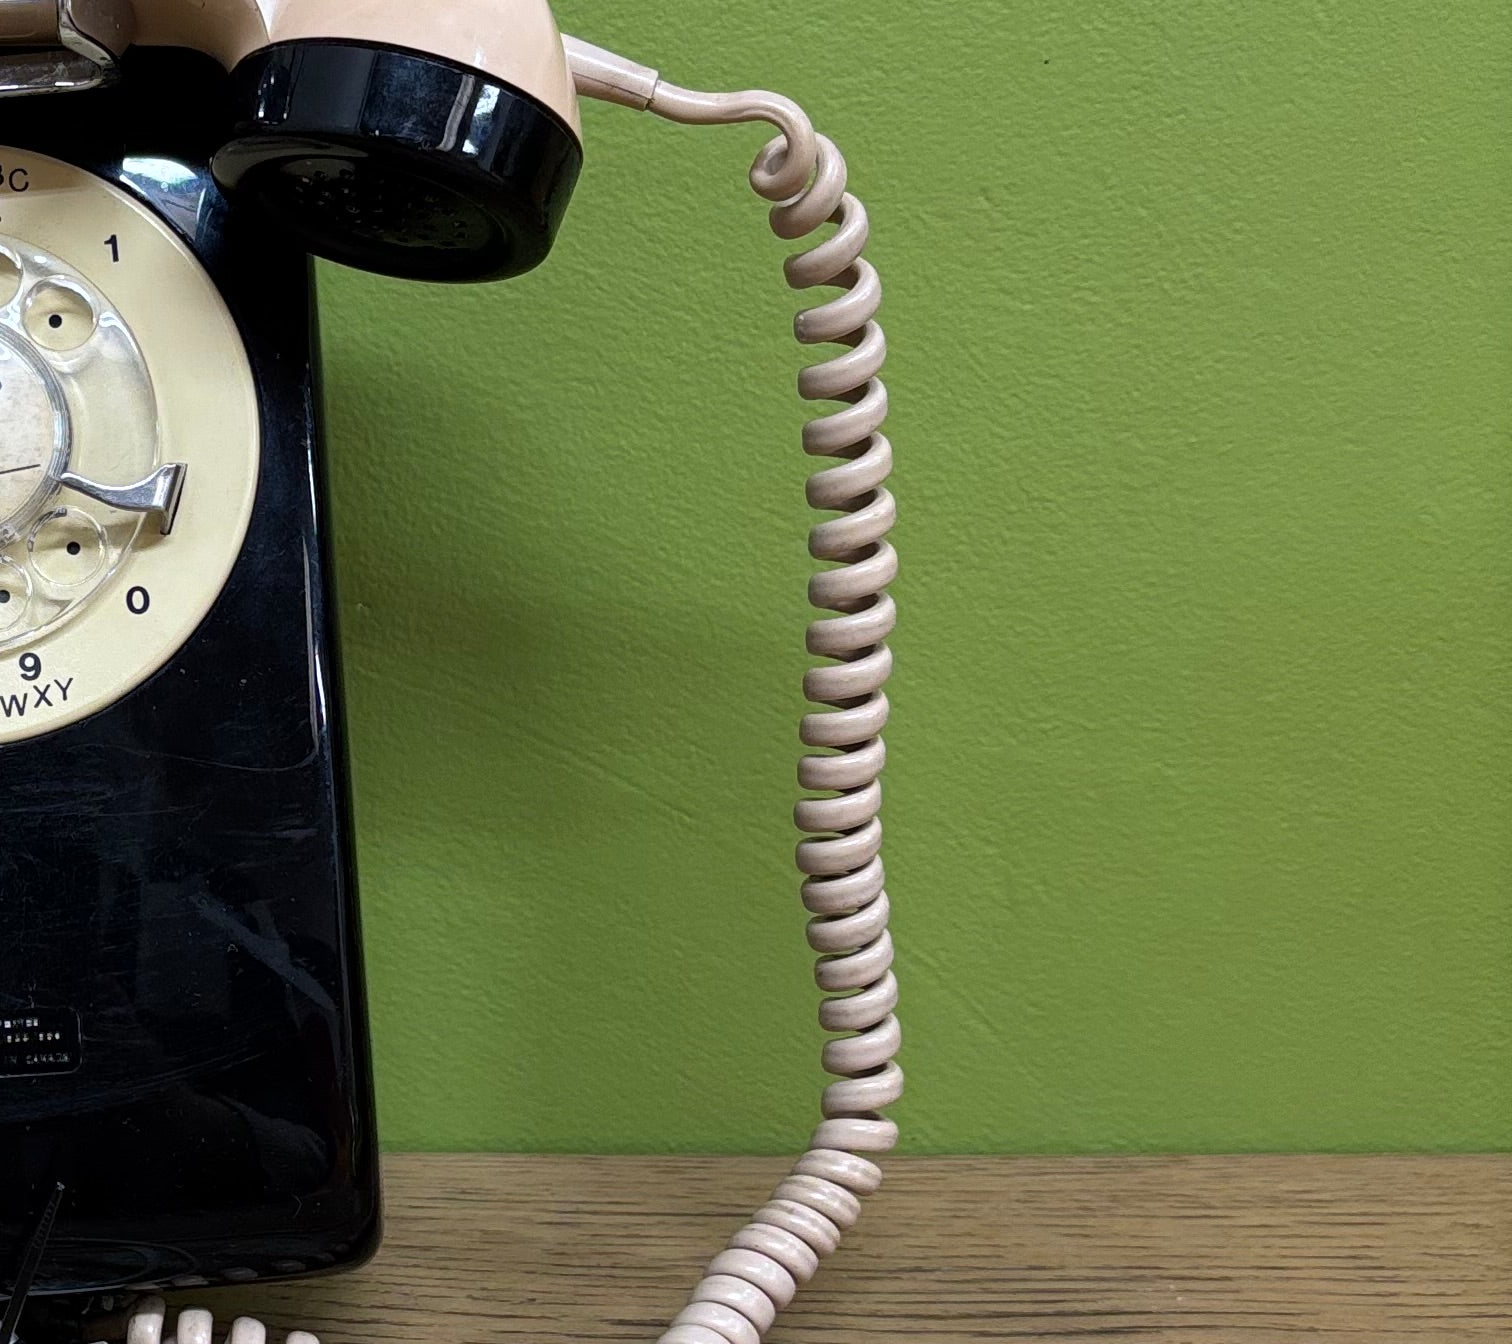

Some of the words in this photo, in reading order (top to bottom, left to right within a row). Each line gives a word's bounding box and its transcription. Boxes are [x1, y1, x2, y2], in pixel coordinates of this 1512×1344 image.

[104, 234, 119, 262] 1
[126, 586, 150, 615] 0
[19, 652, 41, 681] 9
[0, 678, 73, 718] WXY
